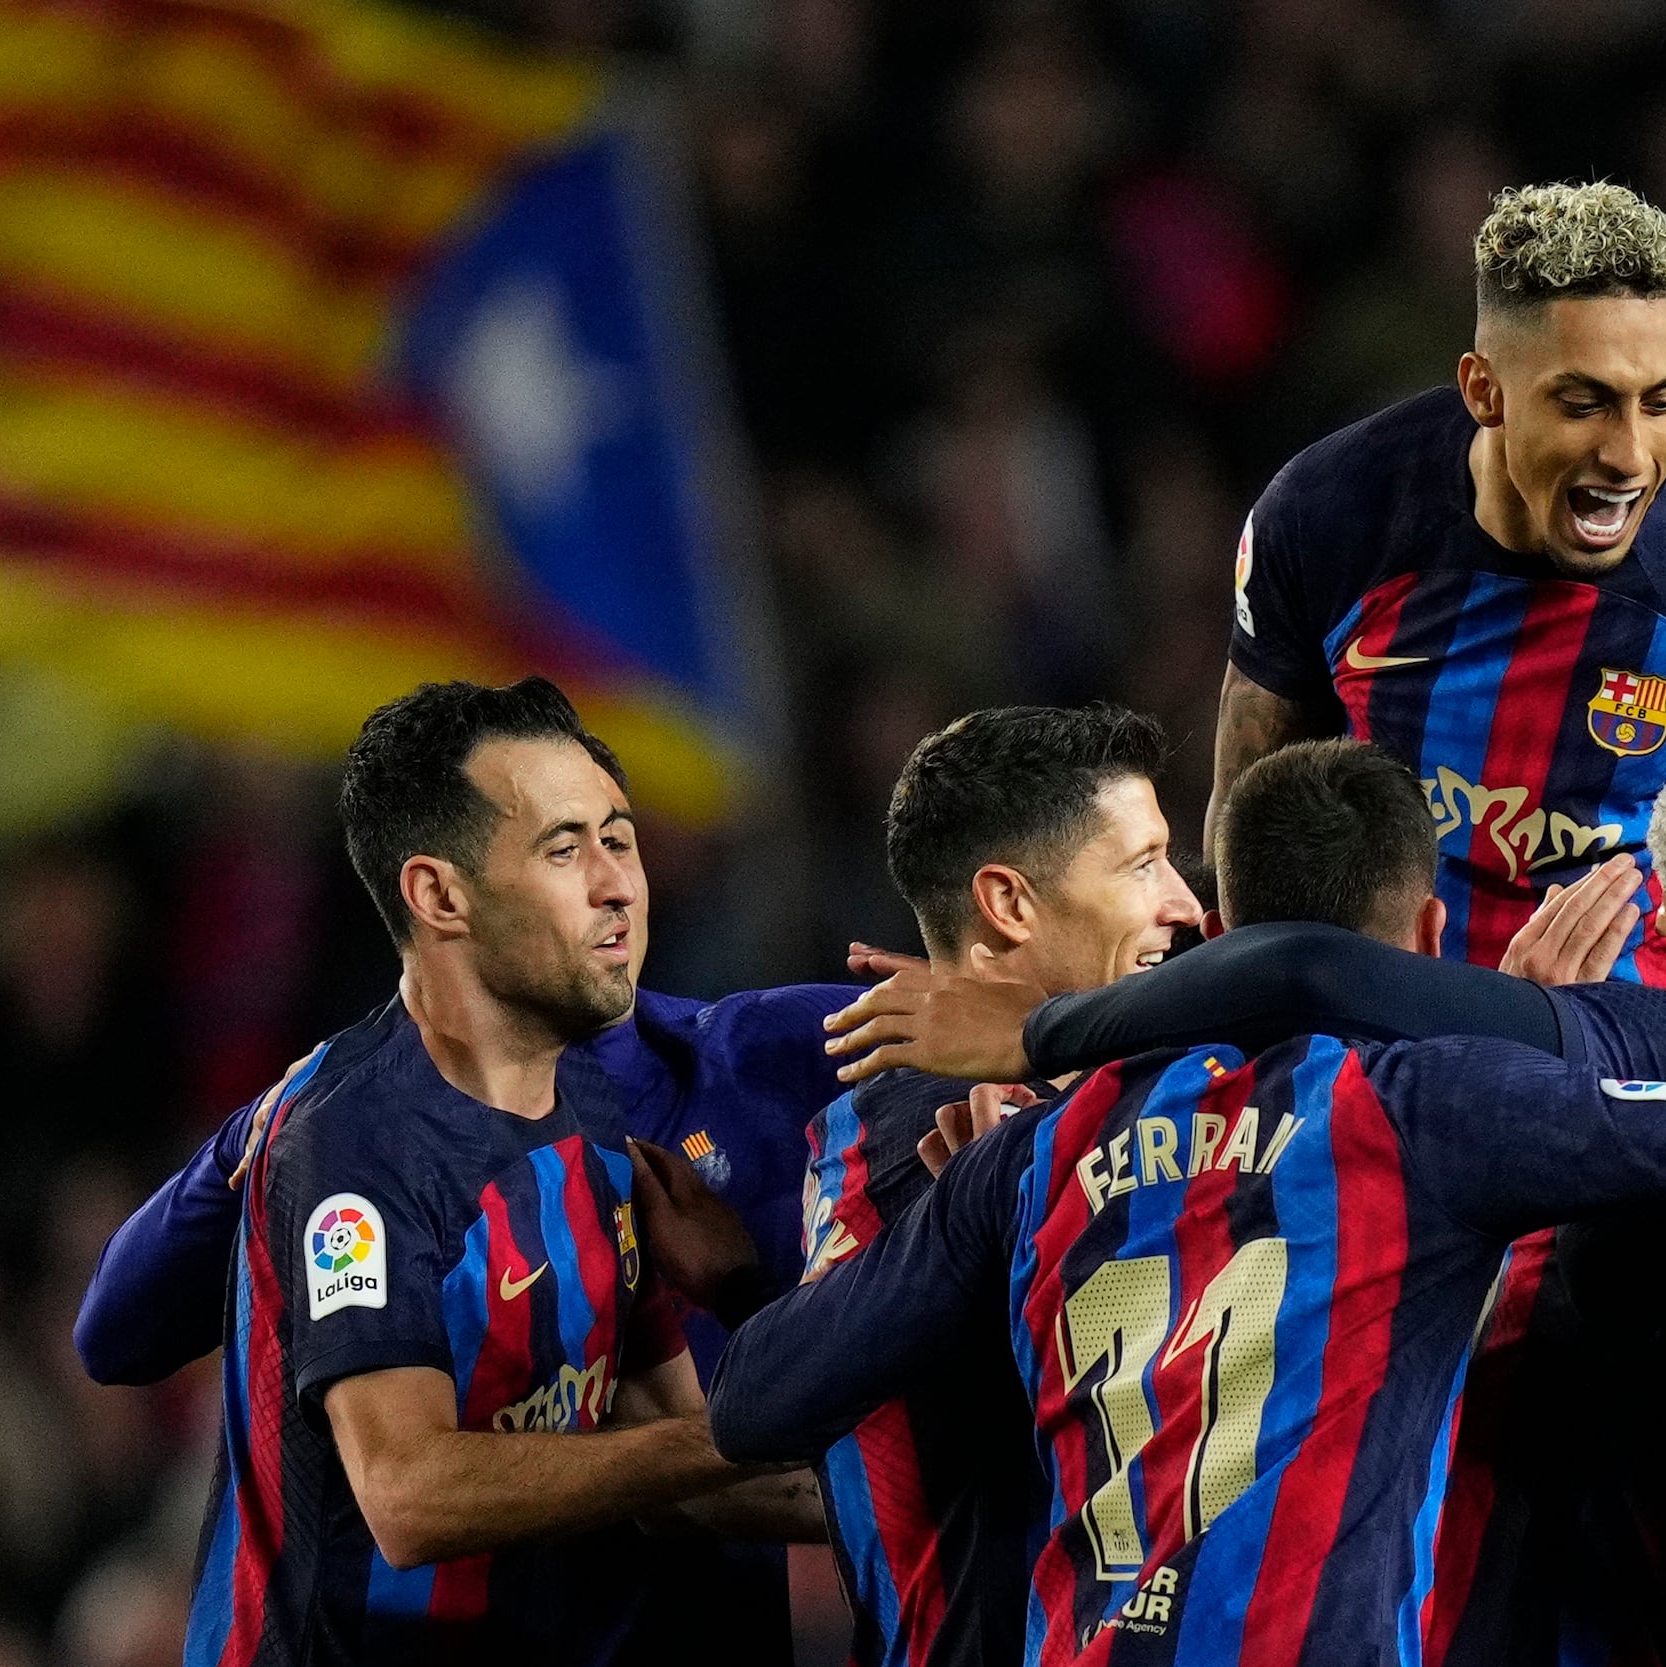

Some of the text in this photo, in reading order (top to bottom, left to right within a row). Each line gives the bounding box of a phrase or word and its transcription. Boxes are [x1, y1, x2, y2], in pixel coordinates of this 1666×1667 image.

[1615, 703, 1647, 719] FCB
[1076, 1107, 1307, 1217] FERRAN
[317, 1272, 378, 1302] LaLiga
[1126, 1622, 1167, 1637] Agency
